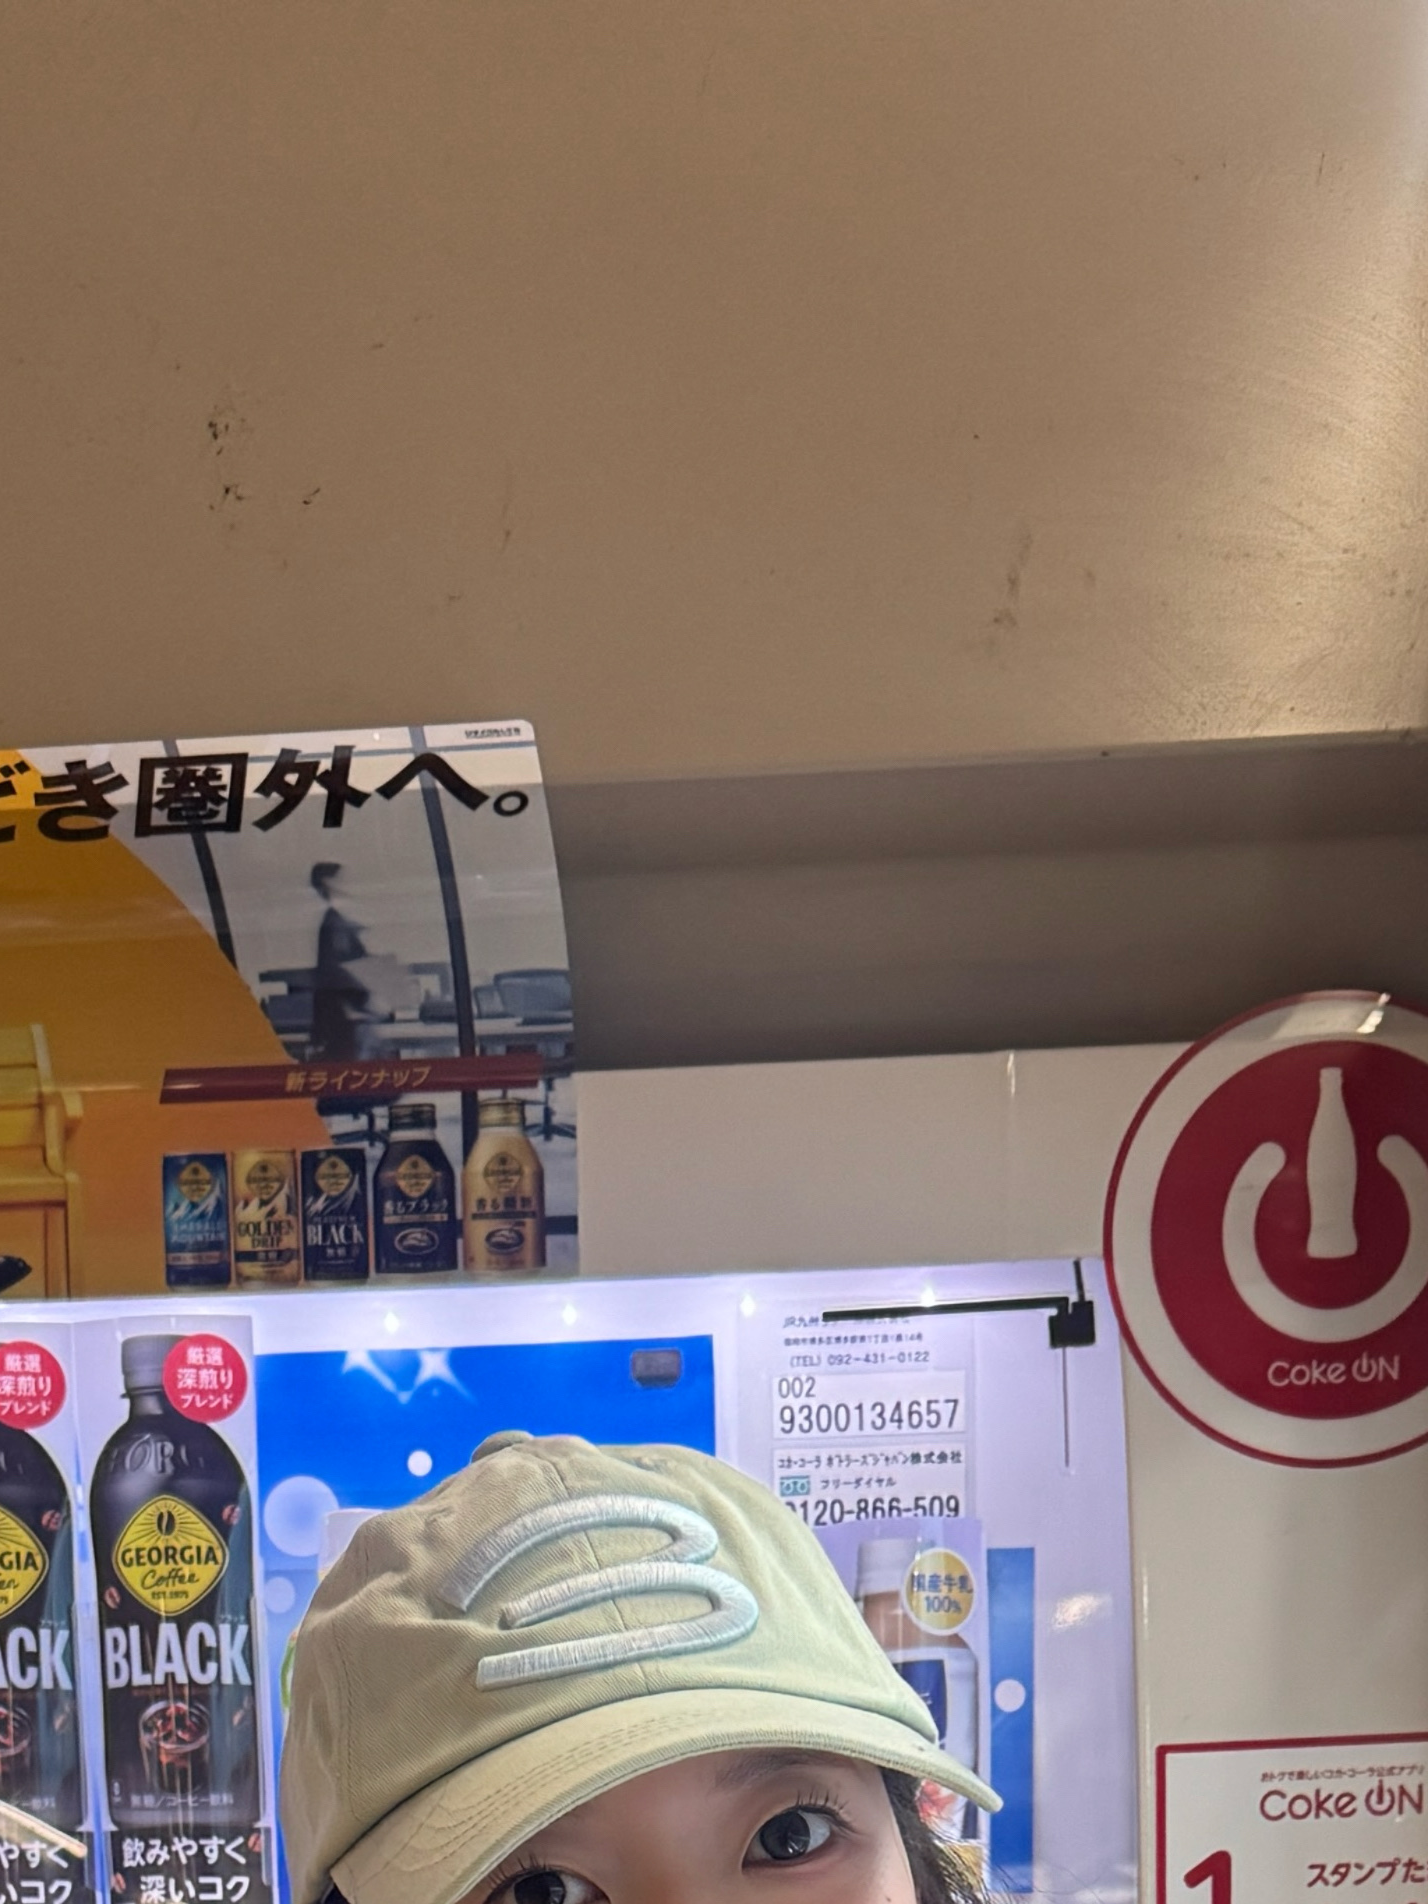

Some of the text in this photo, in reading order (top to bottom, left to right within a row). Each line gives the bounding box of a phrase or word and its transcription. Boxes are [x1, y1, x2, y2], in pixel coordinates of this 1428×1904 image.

[285, 1067, 432, 1092] 新ラインナップ
[307, 1226, 364, 1245] BLACK
[4, 1353, 41, 1372] 厳選
[187, 1346, 223, 1365] 厳選
[177, 1368, 234, 1390] 深煎り
[1268, 1352, 1401, 1386] Coke ON
[778, 1377, 816, 1398] 002
[0, 1400, 52, 1415] ブレンド
[180, 1393, 233, 1409] ブレンド
[780, 1399, 959, 1434] 9300134657
[821, 1477, 897, 1490] フリーダイヤル
[121, 1545, 220, 1567] GEORGIA
[140, 1569, 200, 1591] Coffee
[104, 1622, 251, 1689] BLACK
[1260, 1779, 1425, 1822] Coke ON
[122, 1837, 247, 1869] 飲みやすく
[140, 1874, 251, 1904] 深いコク
